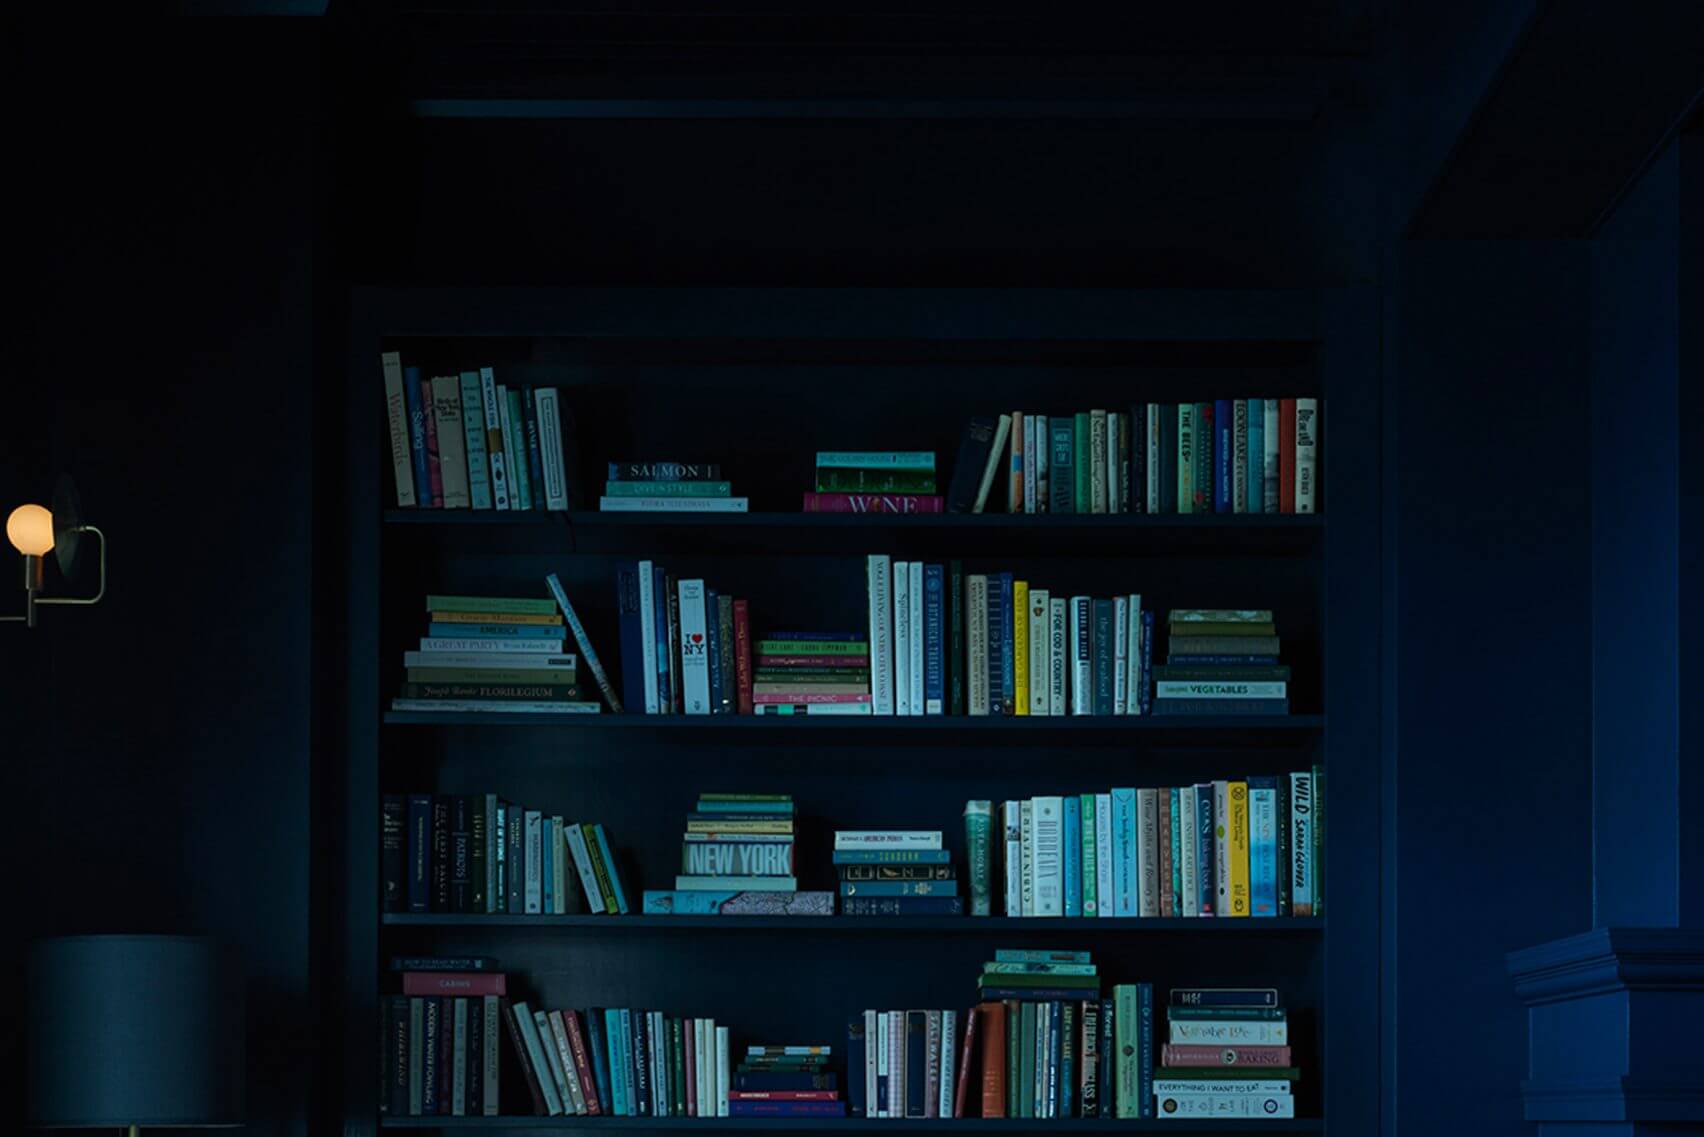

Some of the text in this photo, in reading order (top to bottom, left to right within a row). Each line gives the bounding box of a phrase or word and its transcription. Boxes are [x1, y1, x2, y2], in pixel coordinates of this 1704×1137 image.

[389, 393, 407, 466] Waterbirds
[630, 464, 699, 477] SALMON
[898, 593, 908, 640] Spineless
[1053, 614, 1063, 630] FOR
[684, 644, 705, 656] NY
[685, 634, 691, 644] I
[1053, 659, 1063, 697] COUNTRY
[1189, 685, 1249, 695] VEGETABLES
[479, 687, 552, 698] FLORILEGIUM
[1294, 776, 1310, 815] WILD
[688, 844, 790, 875] NEW YORK
[1023, 818, 1033, 904] CABIN FEVER
[1294, 850, 1306, 889] GLOVER
[1104, 1009, 1113, 1037] Forest
[1160, 1083, 1206, 1092] EVERYTHING
[1211, 1083, 1234, 1092] WANT
[1235, 1083, 1246, 1092] TO
